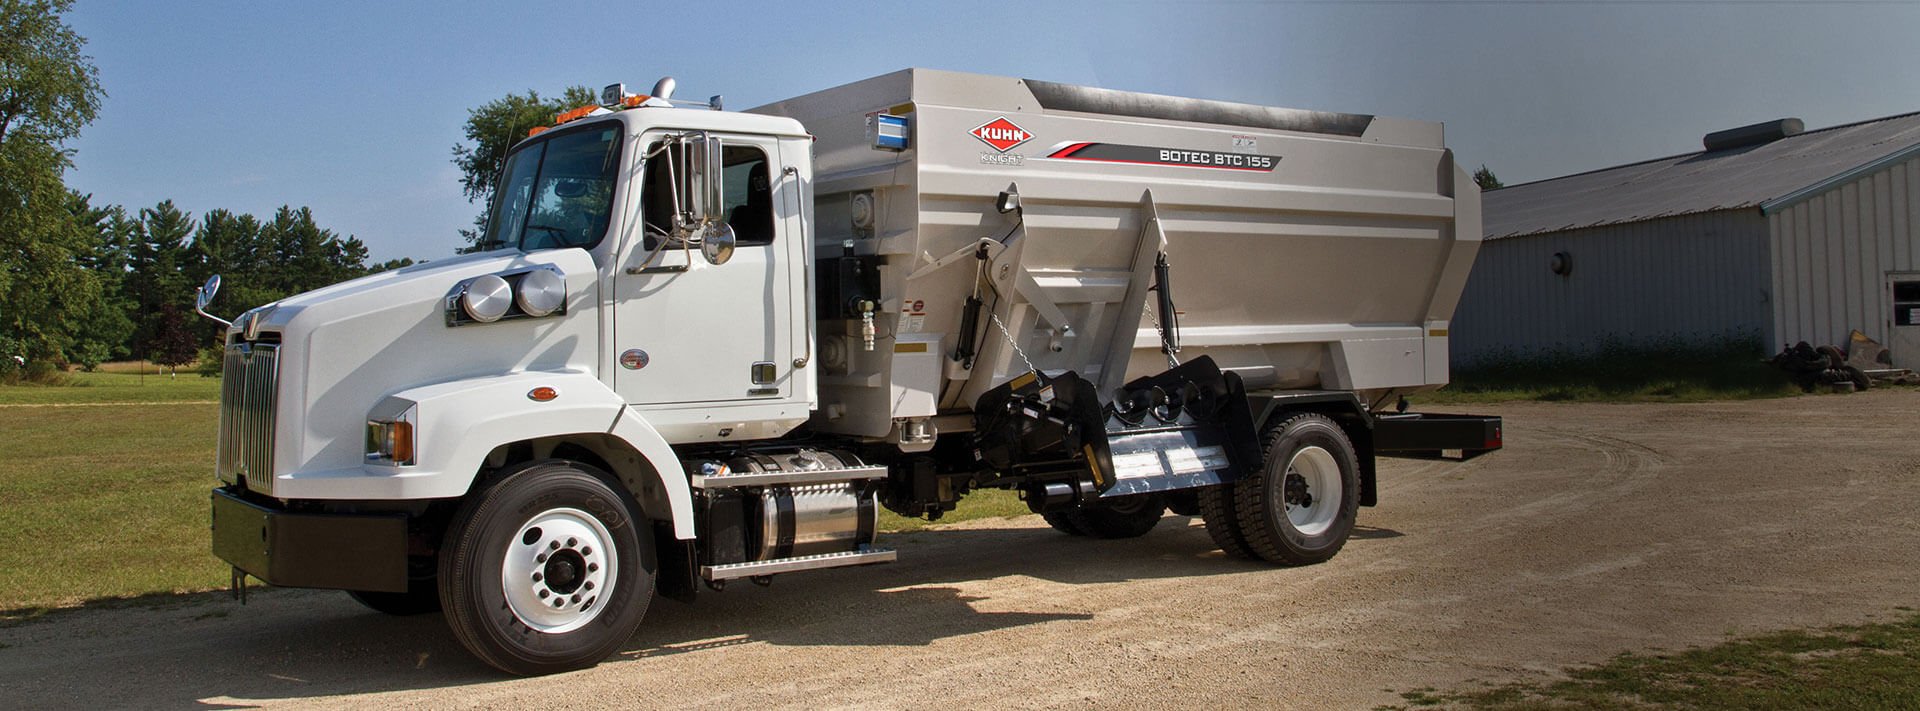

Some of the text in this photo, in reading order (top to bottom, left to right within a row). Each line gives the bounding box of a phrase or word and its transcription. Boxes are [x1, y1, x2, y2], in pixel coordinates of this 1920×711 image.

[980, 127, 1024, 141] KUHN
[980, 152, 1024, 165] KNIGHT
[1159, 150, 1271, 168] BOTEC BTC 155
